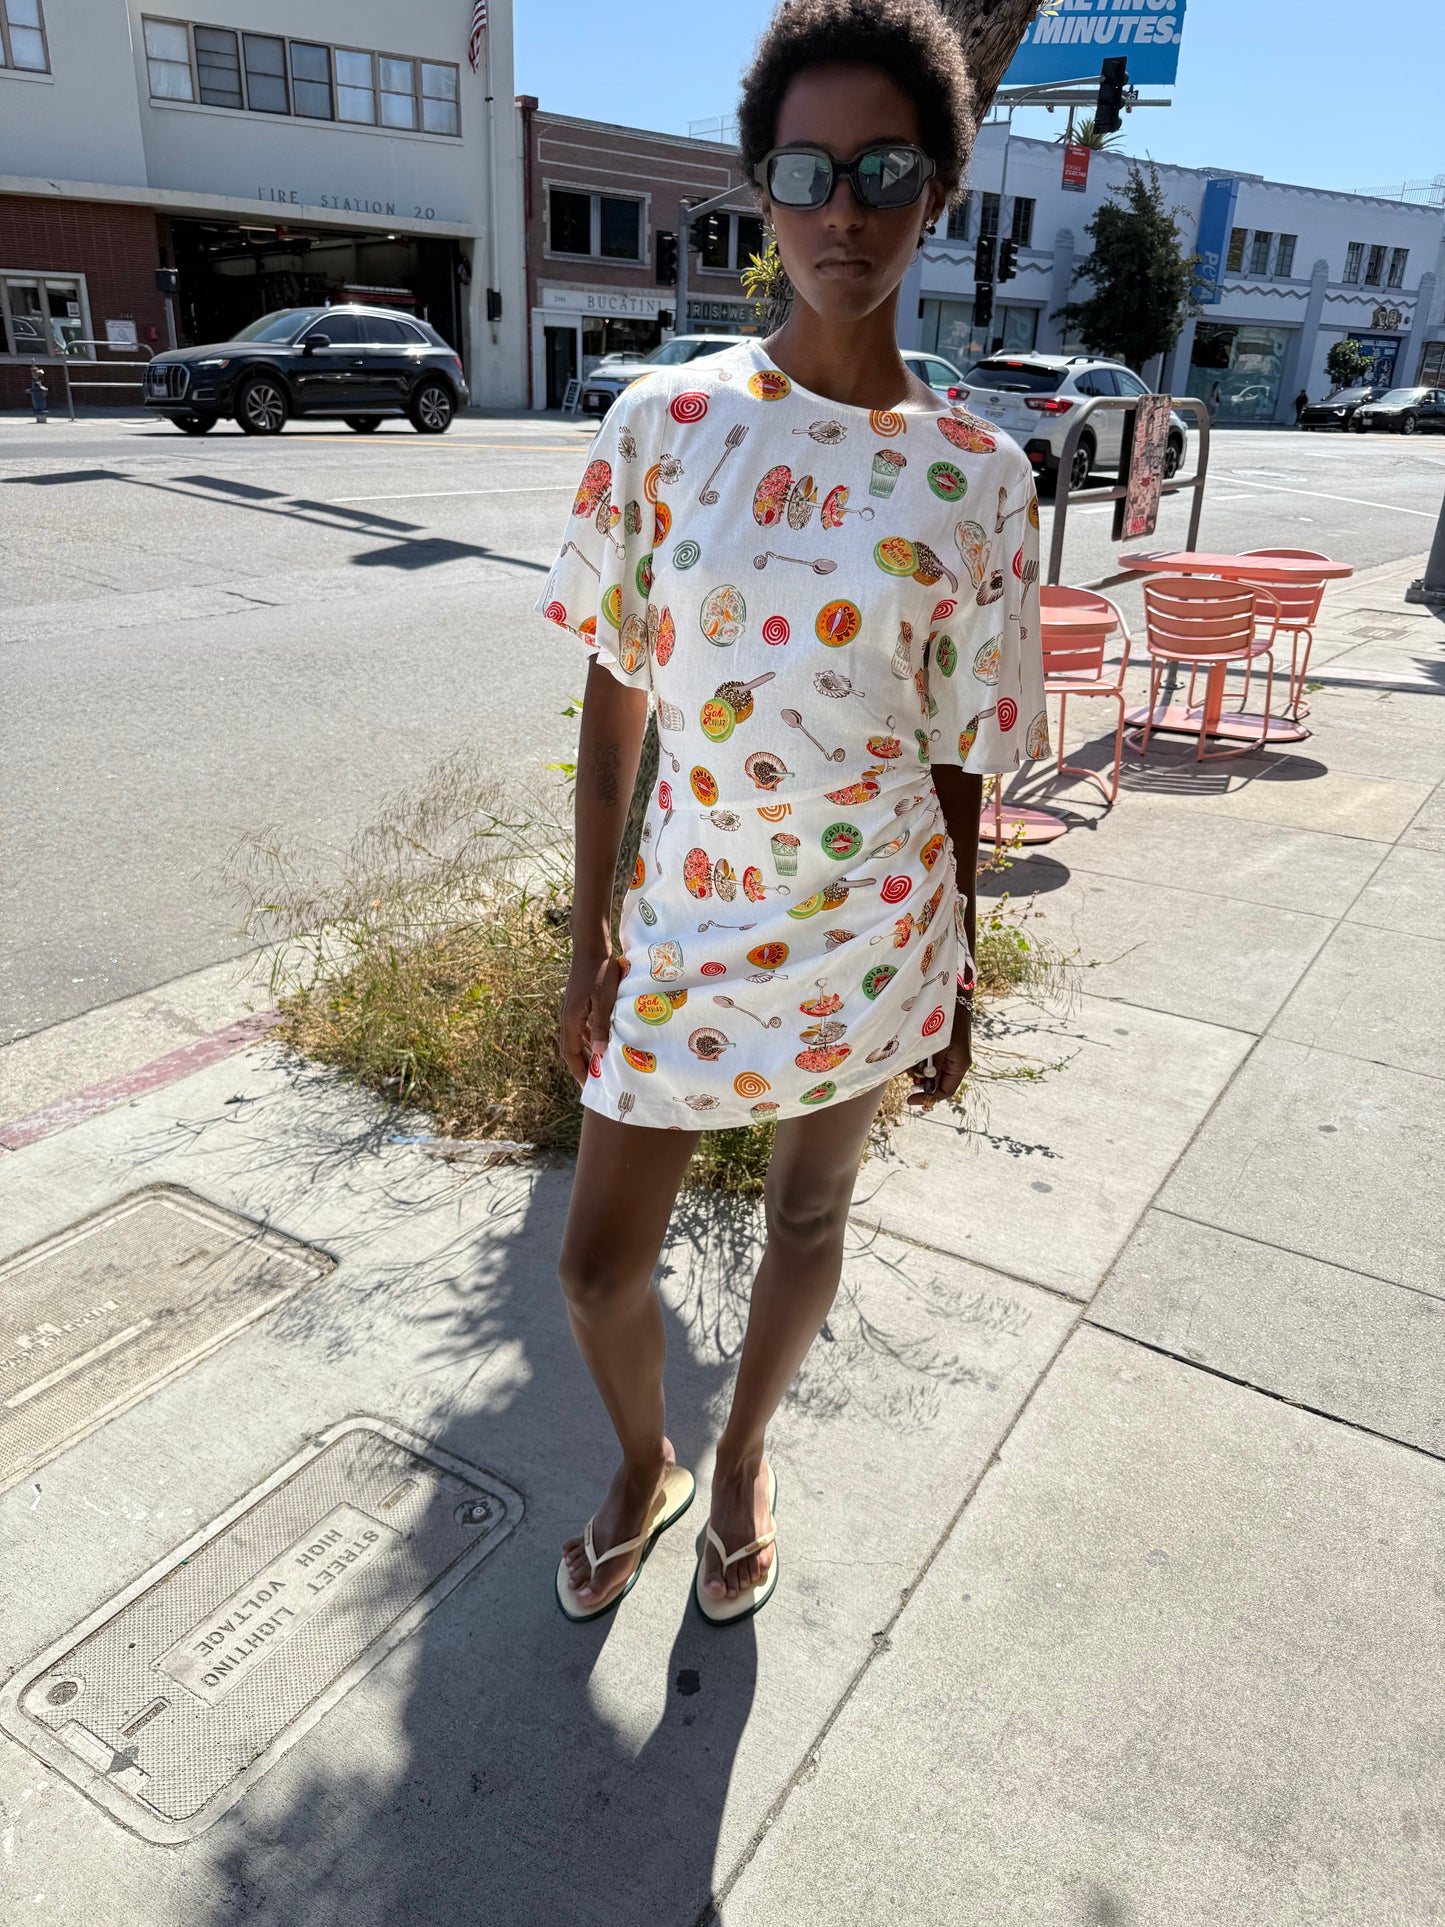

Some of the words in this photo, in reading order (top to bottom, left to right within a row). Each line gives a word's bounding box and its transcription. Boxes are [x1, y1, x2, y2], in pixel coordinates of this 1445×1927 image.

[1032, 16, 1181, 44] MINUTES.
[258, 186, 300, 204] FIRE
[321, 195, 396, 215] STATION
[414, 206, 436, 219] 20
[587, 295, 662, 312] BUCATINI
[931, 464, 965, 484] CAVIAR
[836, 606, 856, 642] CAVIAR
[693, 770, 716, 788] CAVIAR
[824, 825, 859, 843] CAVIAR
[769, 944, 784, 964] CAVIAR
[865, 966, 890, 994] CAVIAR
[295, 1528, 344, 1568] HIGH
[306, 1529, 380, 1596] STREET
[192, 1579, 287, 1657] VOLTAGE
[199, 1606, 296, 1688] LIGHTING
